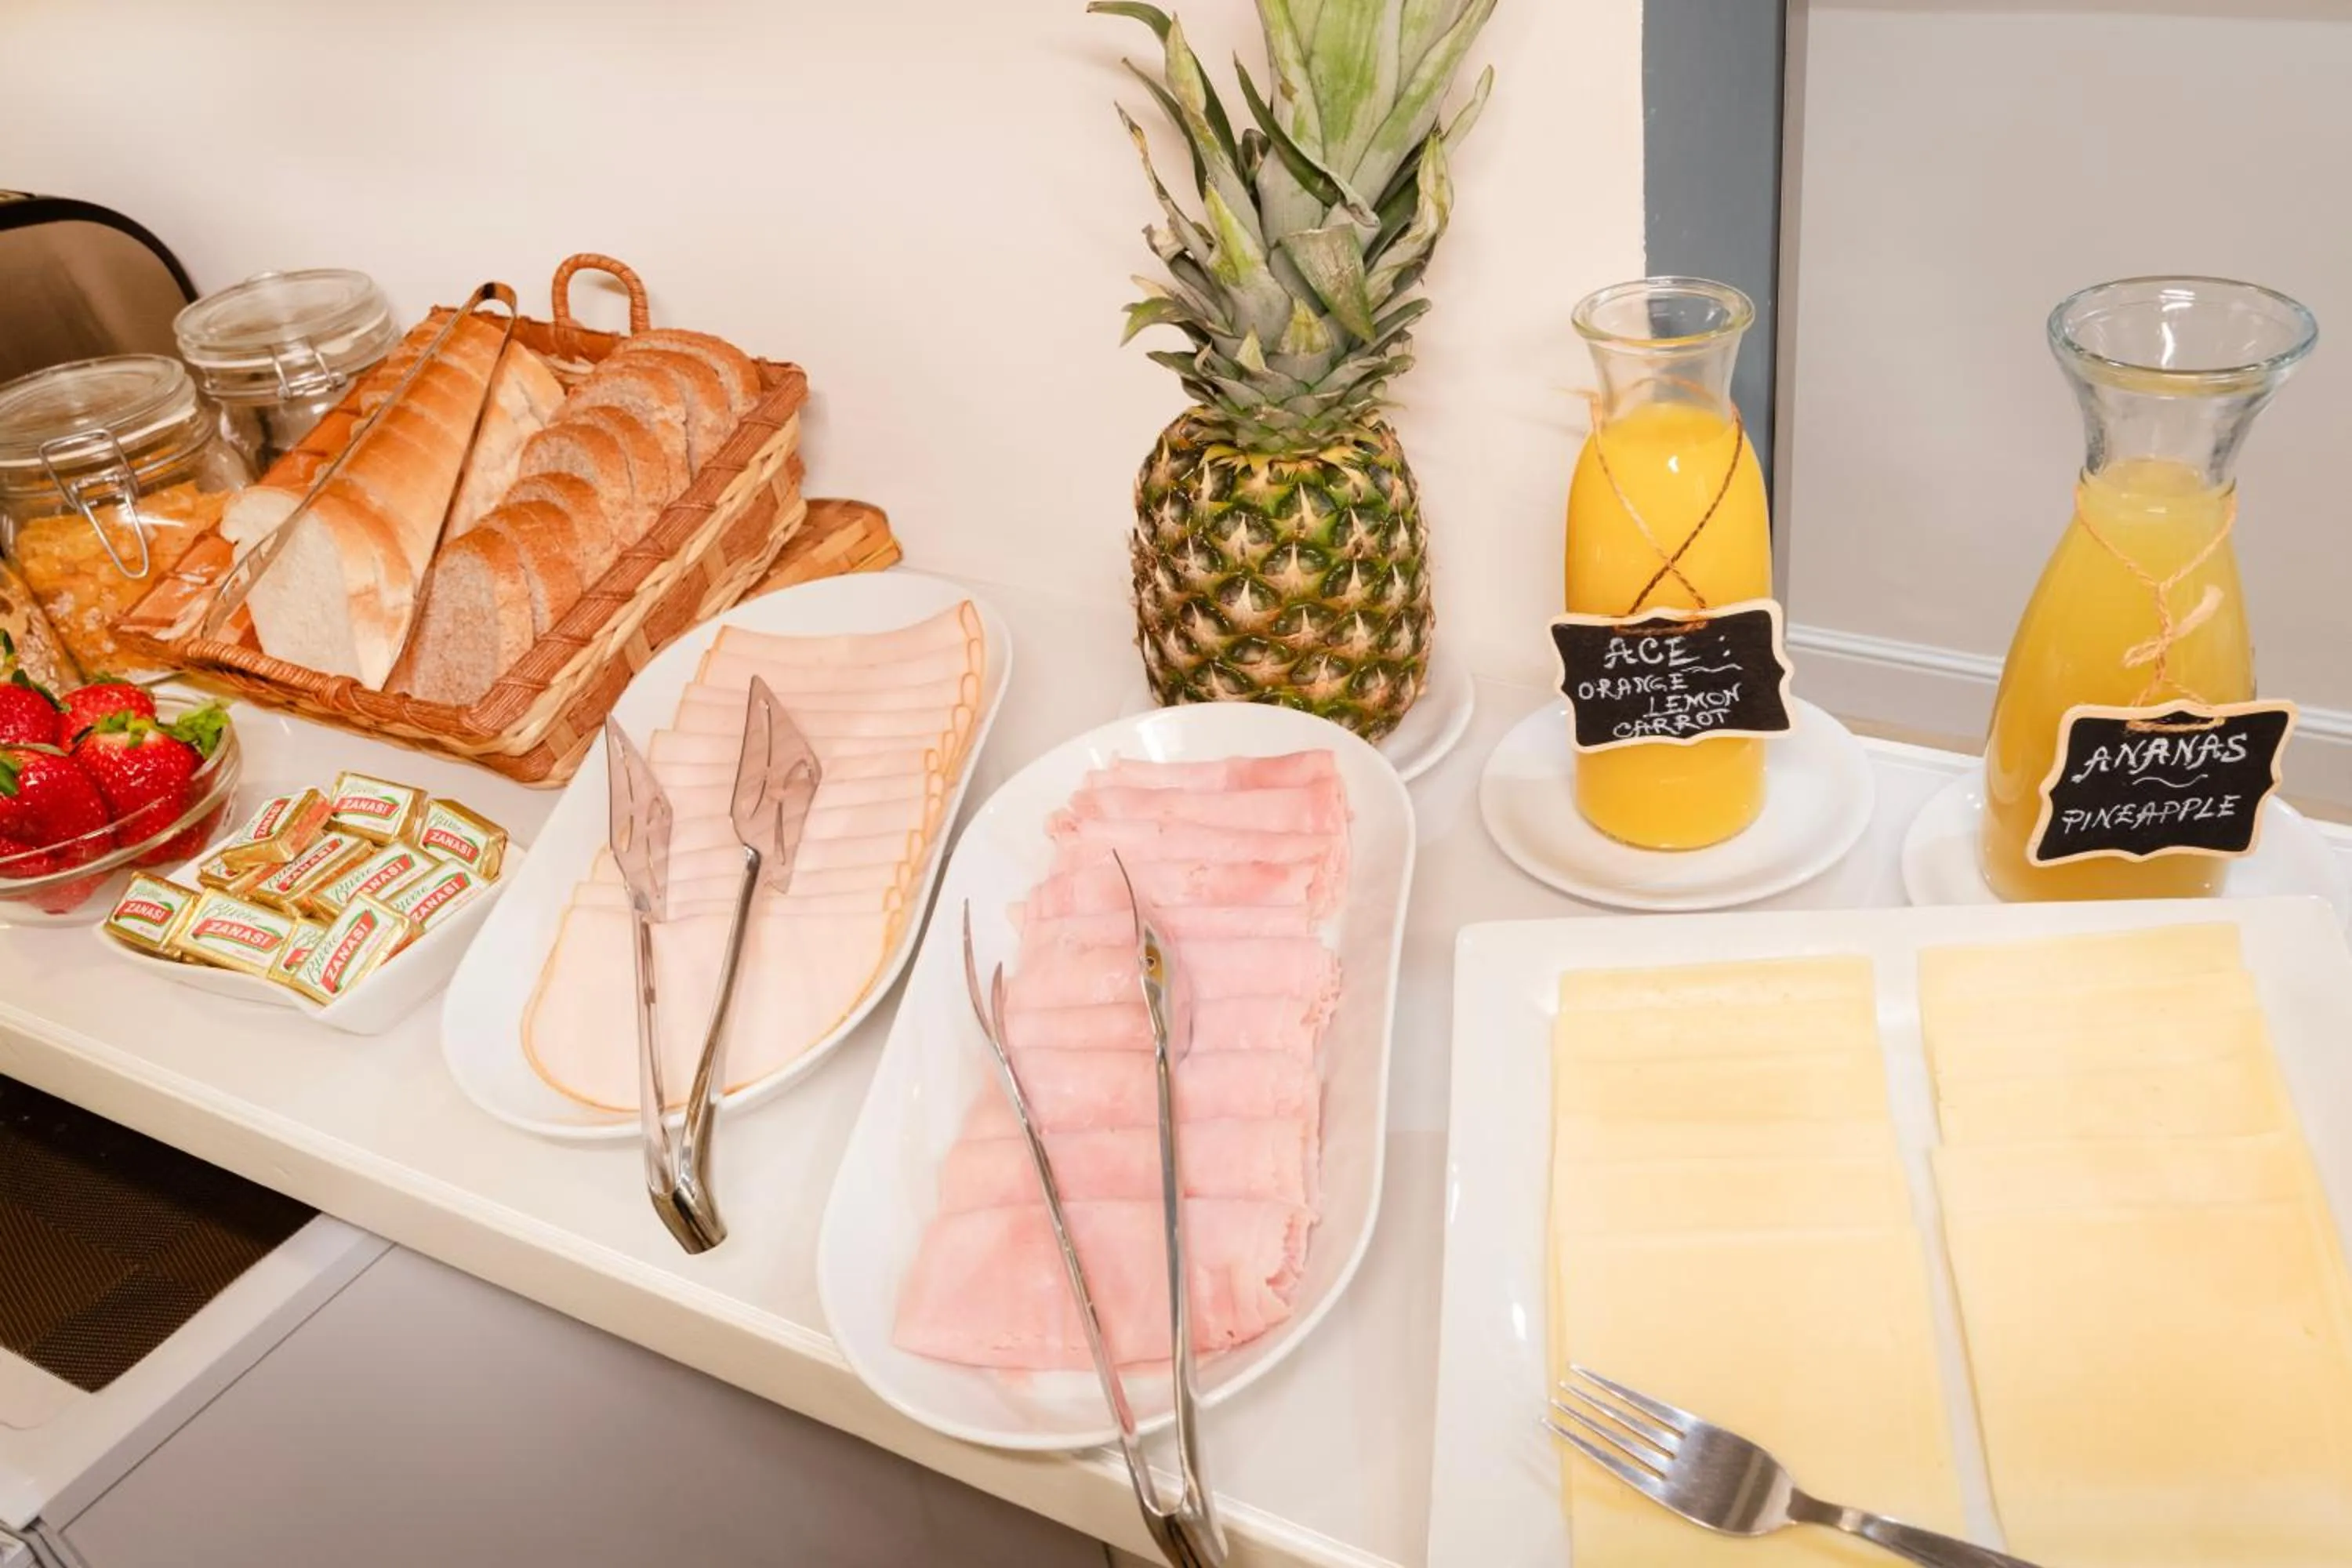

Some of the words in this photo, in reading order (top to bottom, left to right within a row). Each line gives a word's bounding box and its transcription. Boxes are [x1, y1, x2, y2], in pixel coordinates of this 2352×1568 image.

[1578, 673, 1688, 701] ORANGE
[1642, 682, 1743, 718] LEMON
[1613, 708, 1731, 739] CARROT
[2071, 732, 2249, 783] ANANAS
[343, 799, 389, 815] ZANASI
[2061, 794, 2241, 834] PINEAPPLE
[431, 833, 471, 858] ZANASI
[361, 862, 405, 895] ANASI
[124, 902, 165, 921] ZANASI
[411, 880, 461, 924] ZANASI
[209, 920, 270, 948] ZANASI
[325, 921, 369, 981] ZANASI
